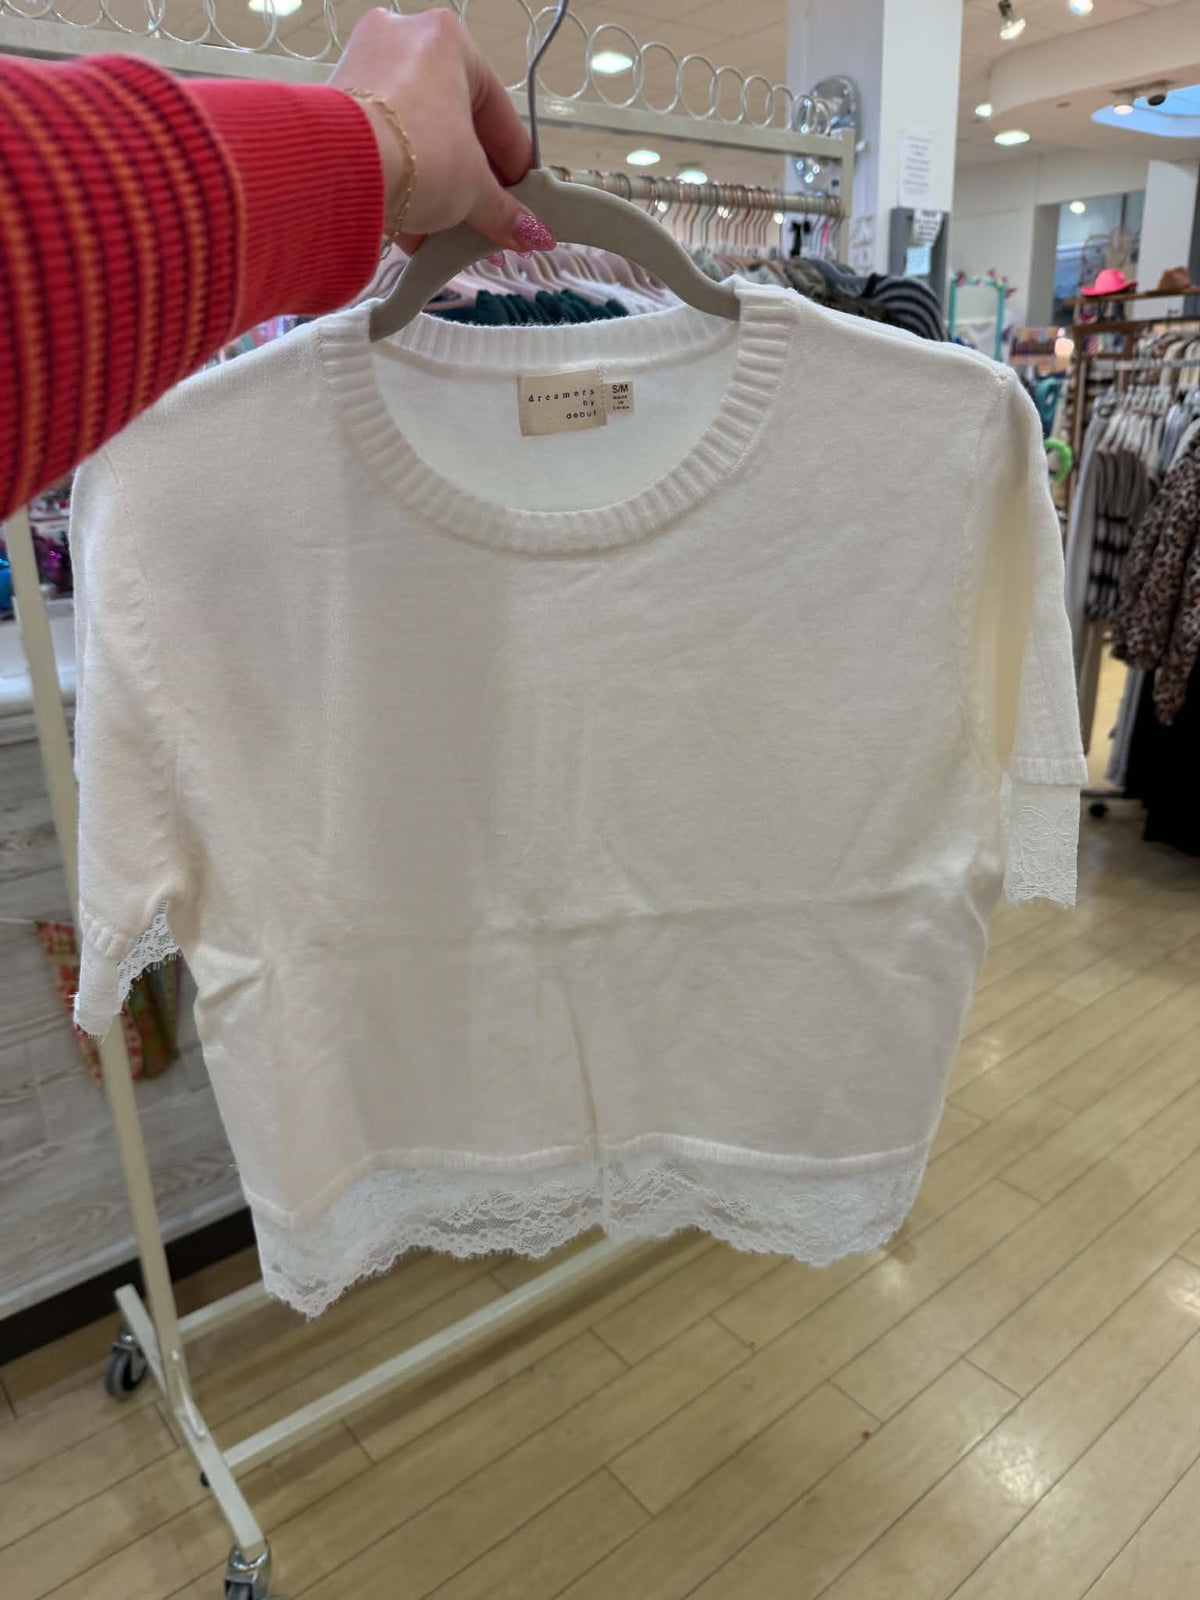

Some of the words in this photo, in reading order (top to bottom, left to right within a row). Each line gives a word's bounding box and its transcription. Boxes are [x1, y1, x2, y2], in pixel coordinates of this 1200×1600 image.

[612, 384, 629, 394] S/M
[528, 388, 595, 403] dreamers
[566, 409, 597, 420] debut
